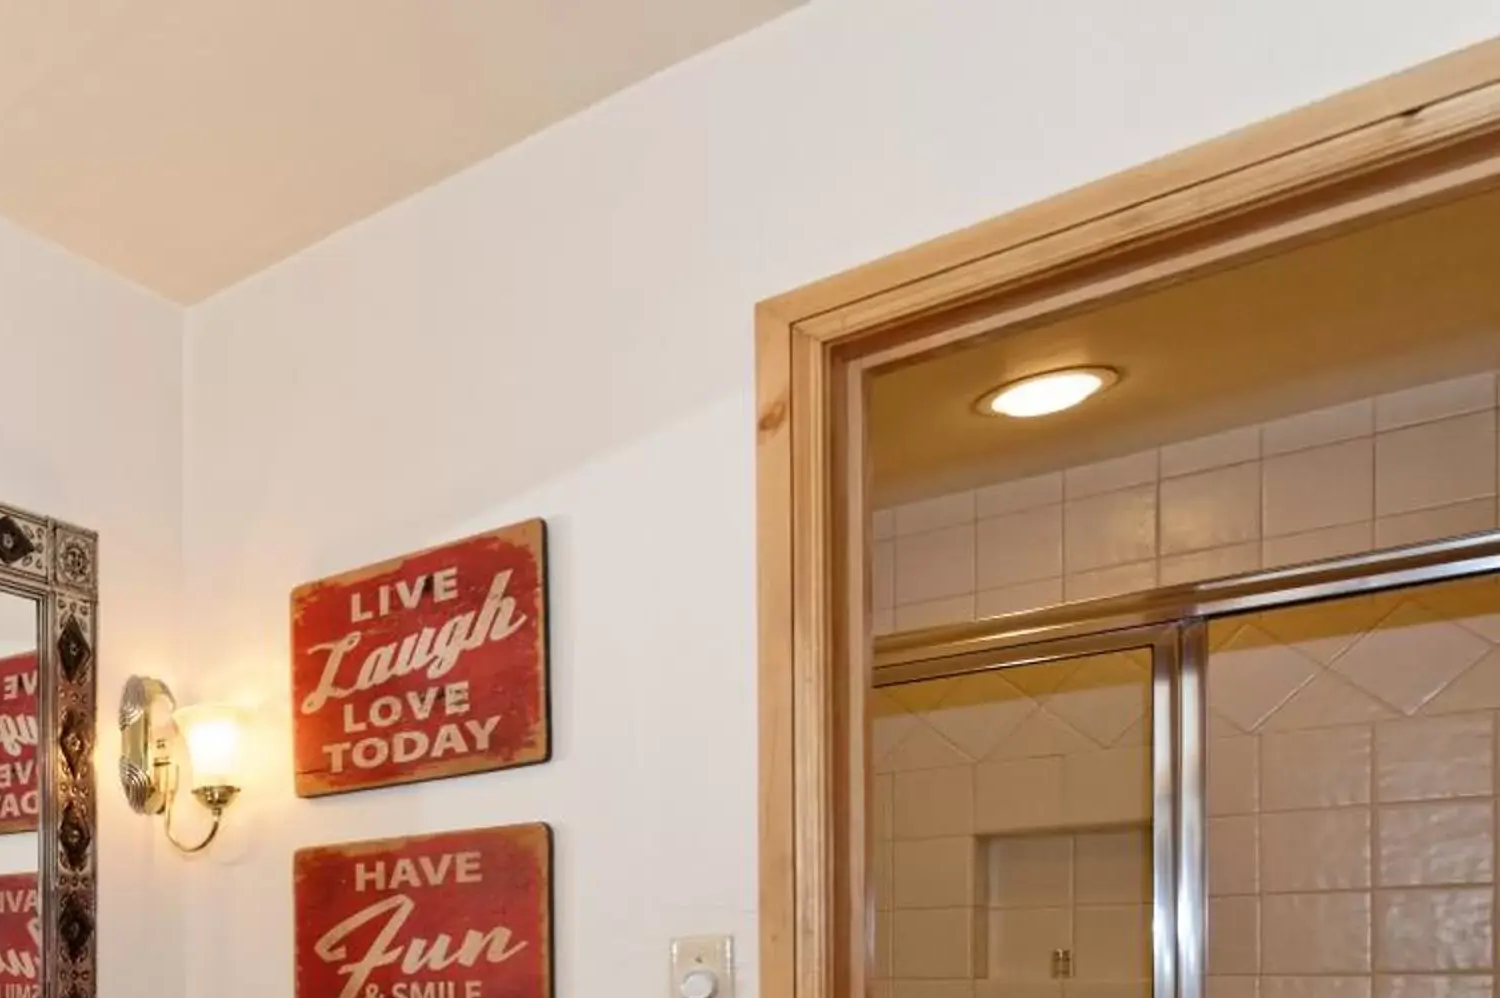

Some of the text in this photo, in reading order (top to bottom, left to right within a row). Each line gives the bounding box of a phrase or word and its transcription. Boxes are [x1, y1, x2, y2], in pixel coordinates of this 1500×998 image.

[351, 567, 458, 623] LIVE
[301, 569, 527, 714] Laugh
[343, 681, 470, 733] LOVE
[323, 715, 500, 773] TODAY
[355, 852, 482, 892] HAVE
